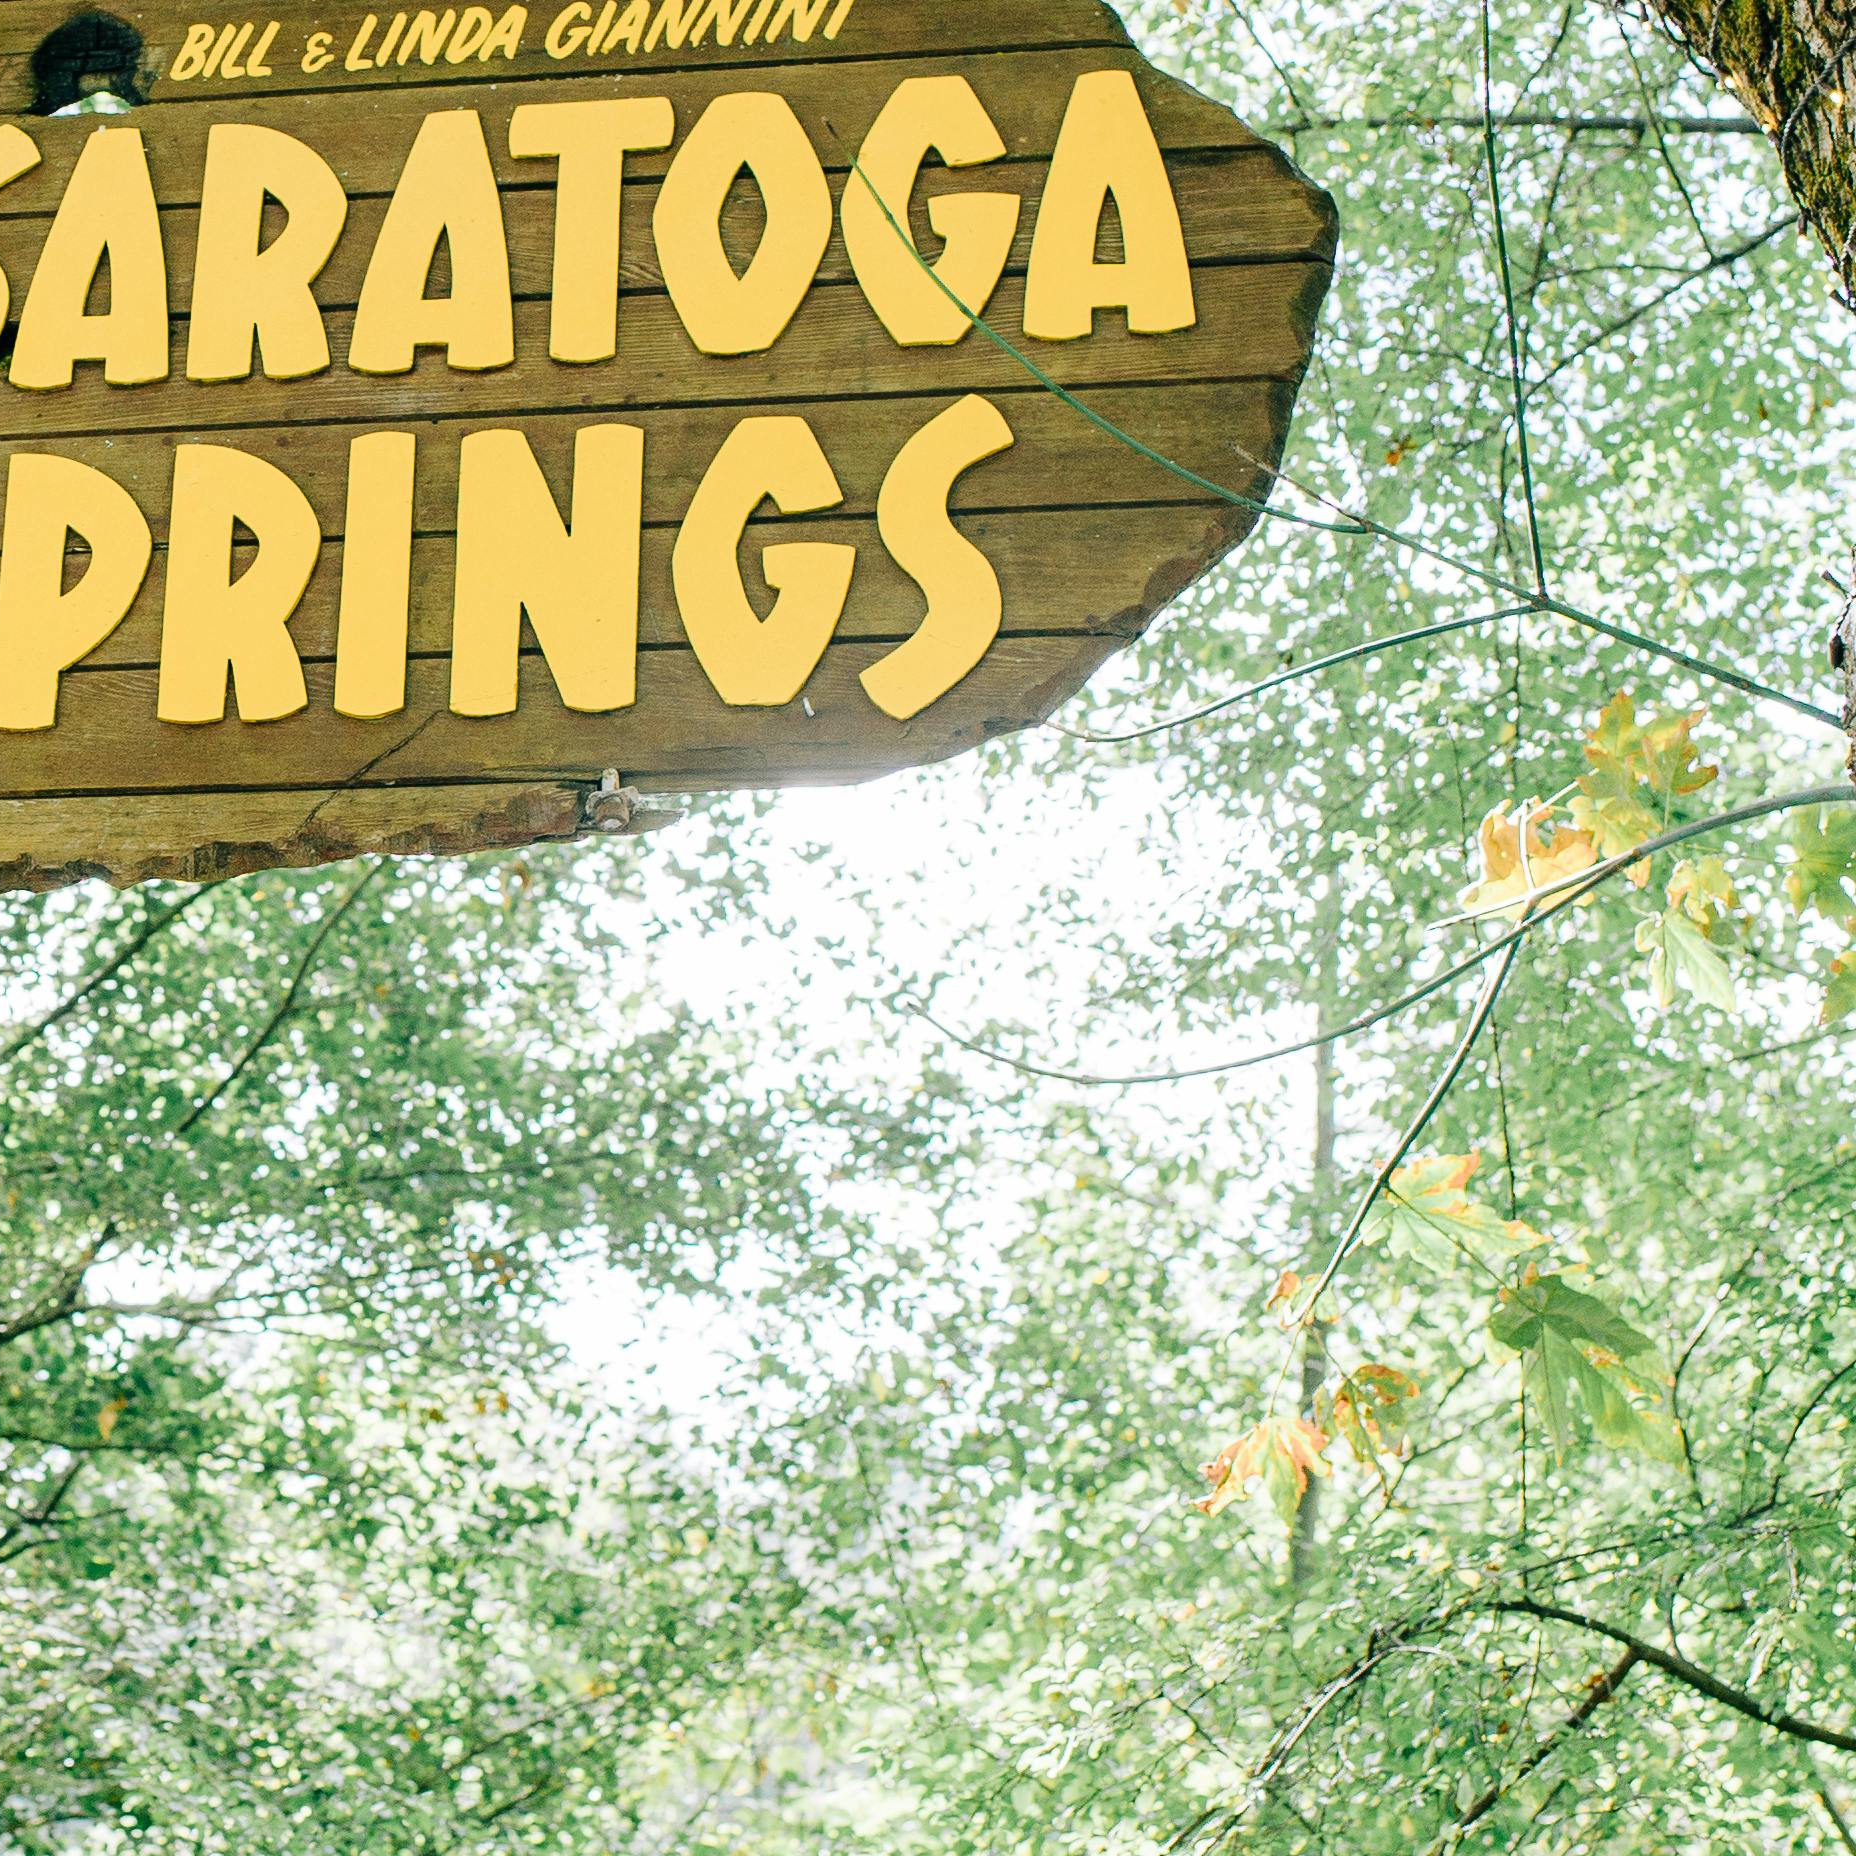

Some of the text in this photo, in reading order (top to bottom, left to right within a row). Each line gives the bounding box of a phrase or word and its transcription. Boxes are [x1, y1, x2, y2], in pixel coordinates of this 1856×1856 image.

[169, 20, 281, 82] BILL
[300, 31, 335, 74] &
[344, 1, 528, 72] LINDA
